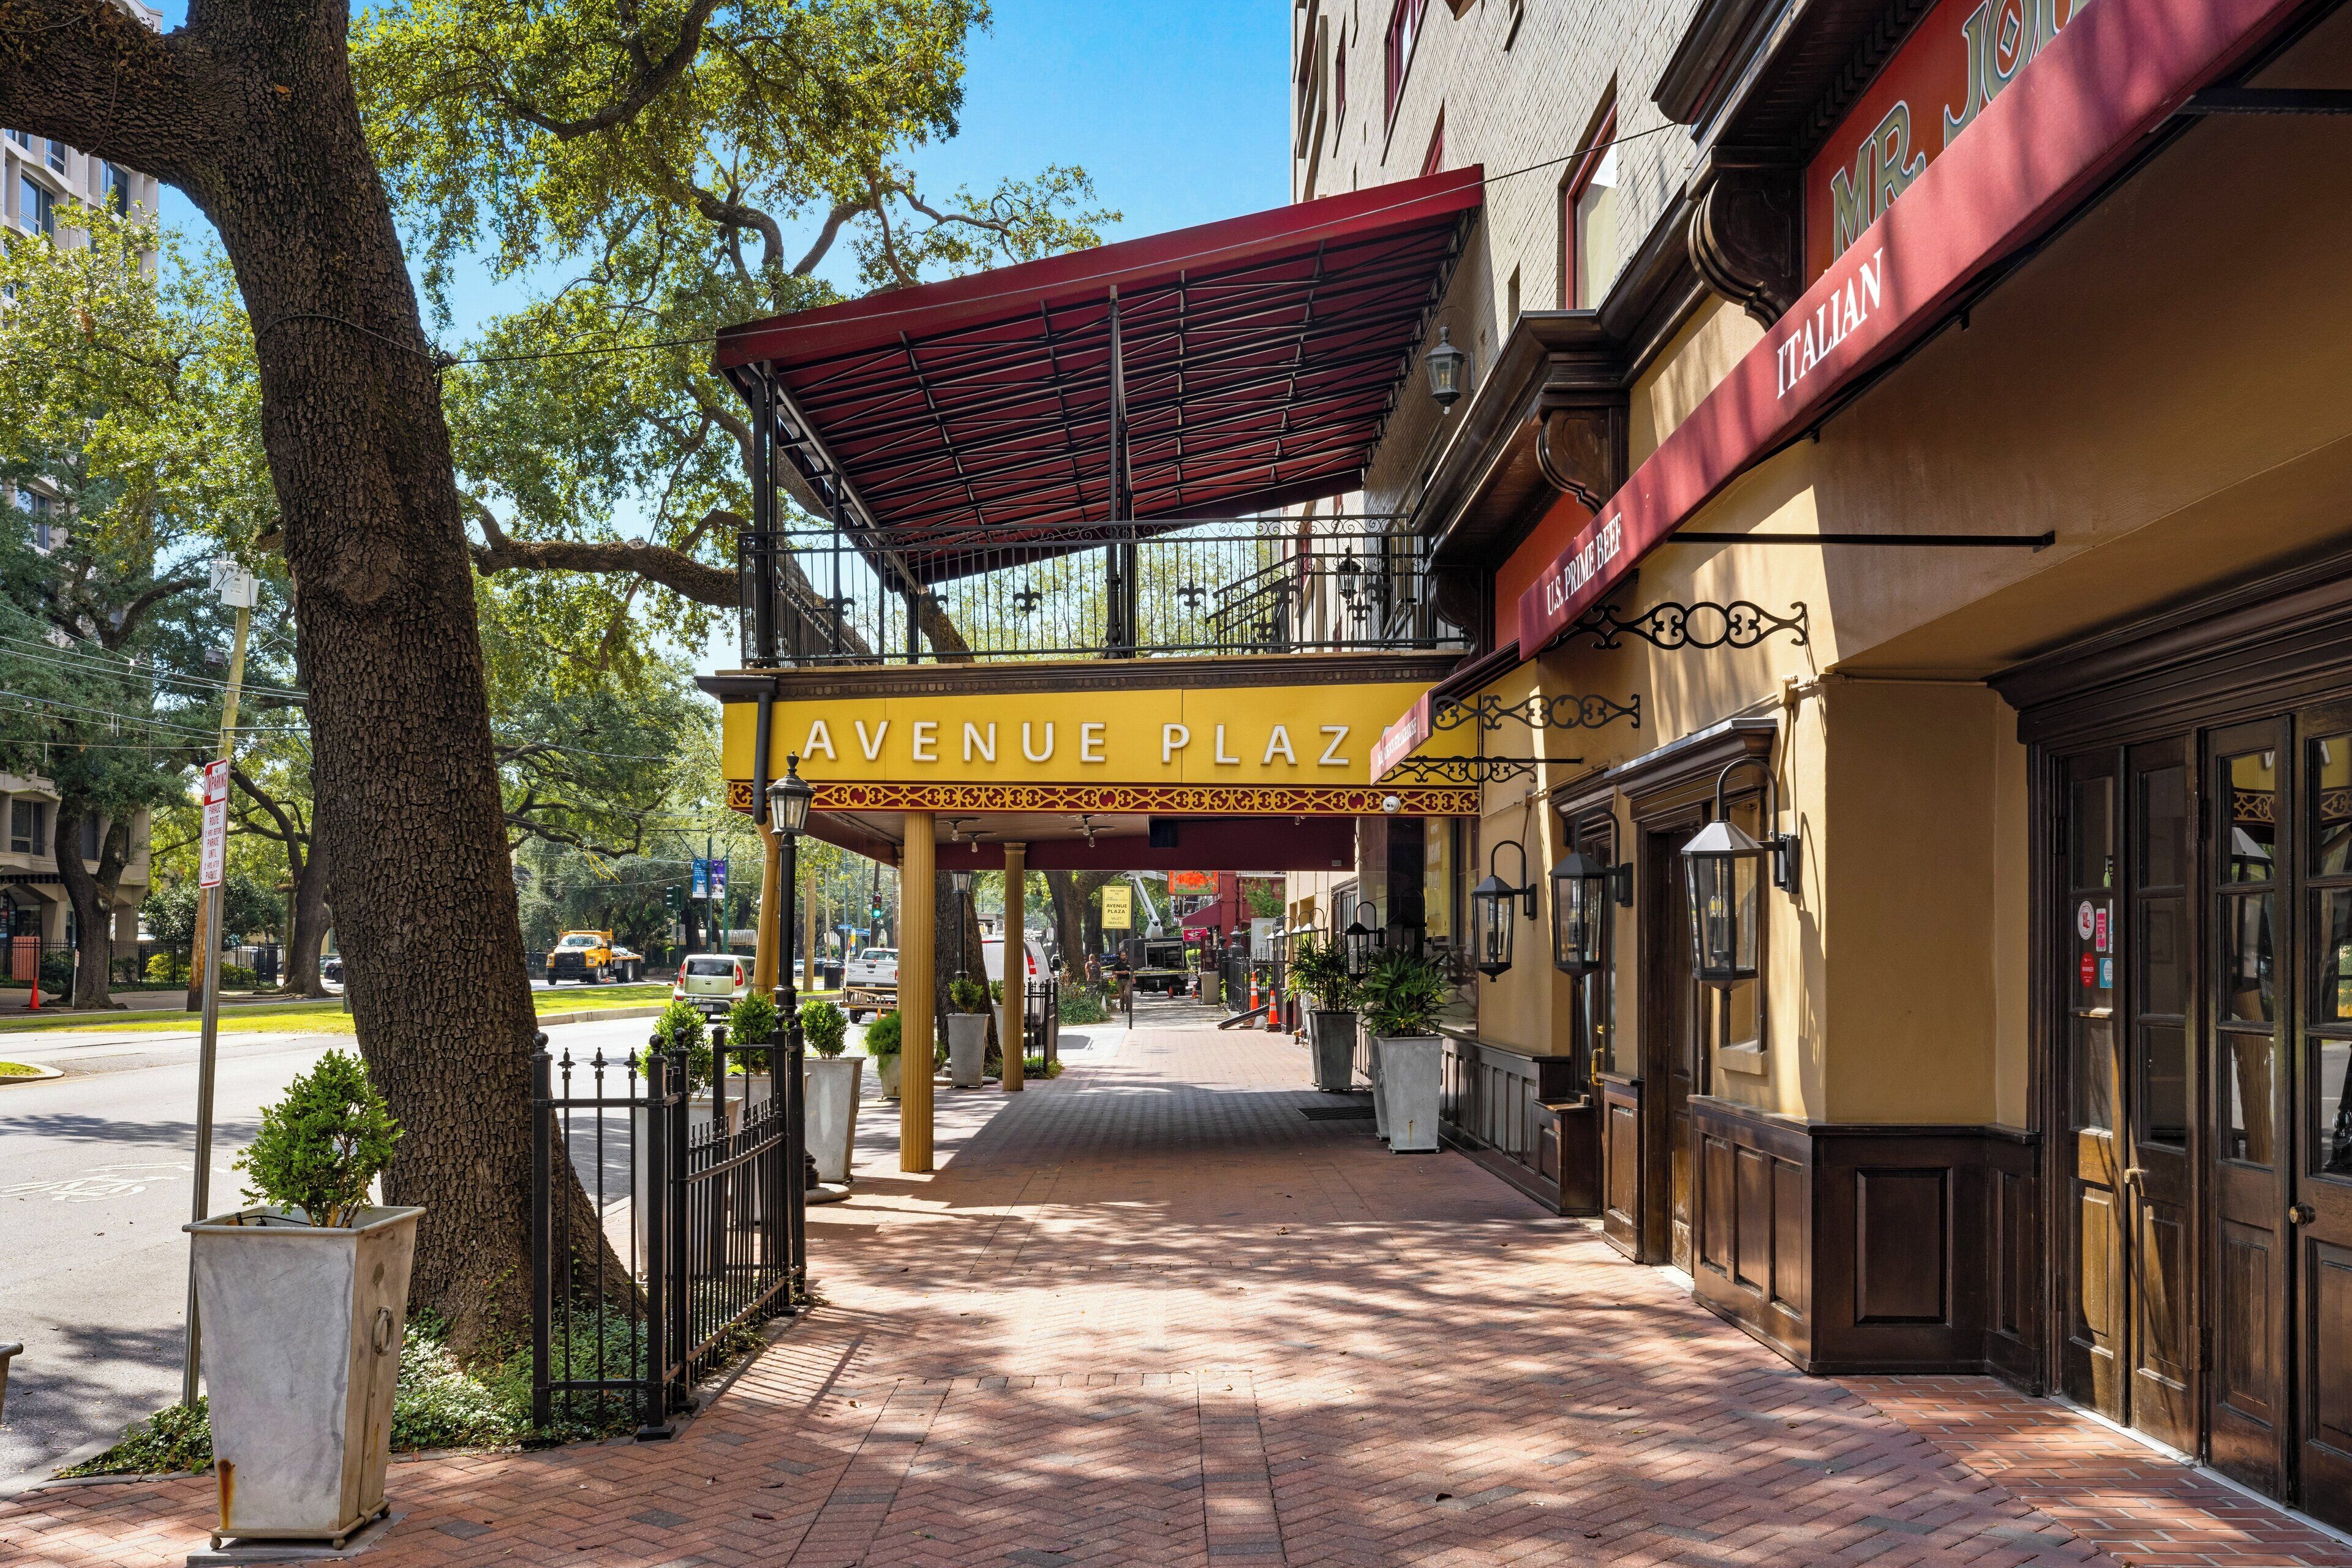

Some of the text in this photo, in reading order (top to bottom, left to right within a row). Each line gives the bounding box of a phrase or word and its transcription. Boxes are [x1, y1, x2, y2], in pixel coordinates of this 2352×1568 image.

[1831, 100, 1926, 265] MR.
[1777, 247, 1883, 399] ITALIAN
[1547, 511, 1621, 616] U.S. PRIME BEEF
[802, 718, 1392, 766] AVENUE PLAZ
[205, 772, 226, 796] NO PARKING
[209, 804, 221, 815] PARADE
[209, 815, 219, 826] ROUTE
[207, 837, 219, 848] PARADE
[208, 848, 217, 859] UNTIL
[205, 870, 217, 881] PARADE
